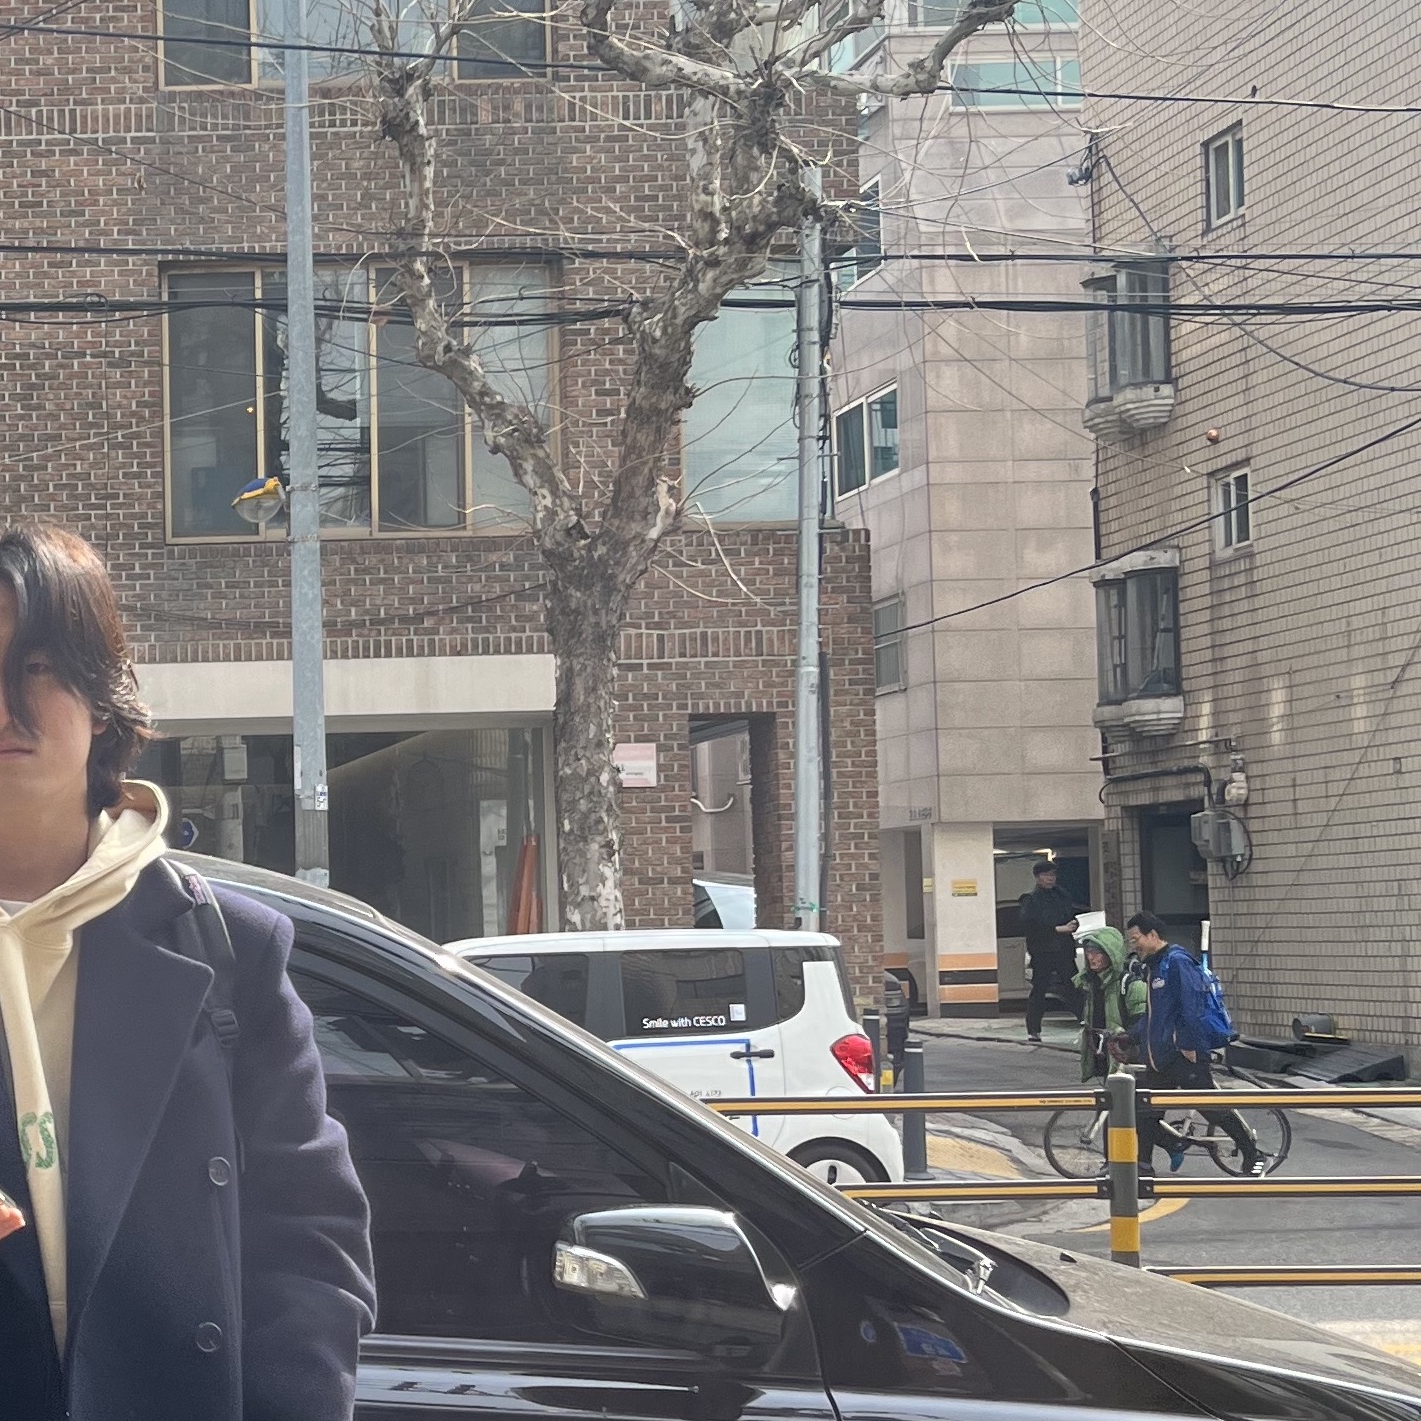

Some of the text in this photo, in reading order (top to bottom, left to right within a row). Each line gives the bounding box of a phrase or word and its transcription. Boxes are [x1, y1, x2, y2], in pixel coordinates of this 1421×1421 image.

[642, 1015, 726, 1029] Smile with CESCO
